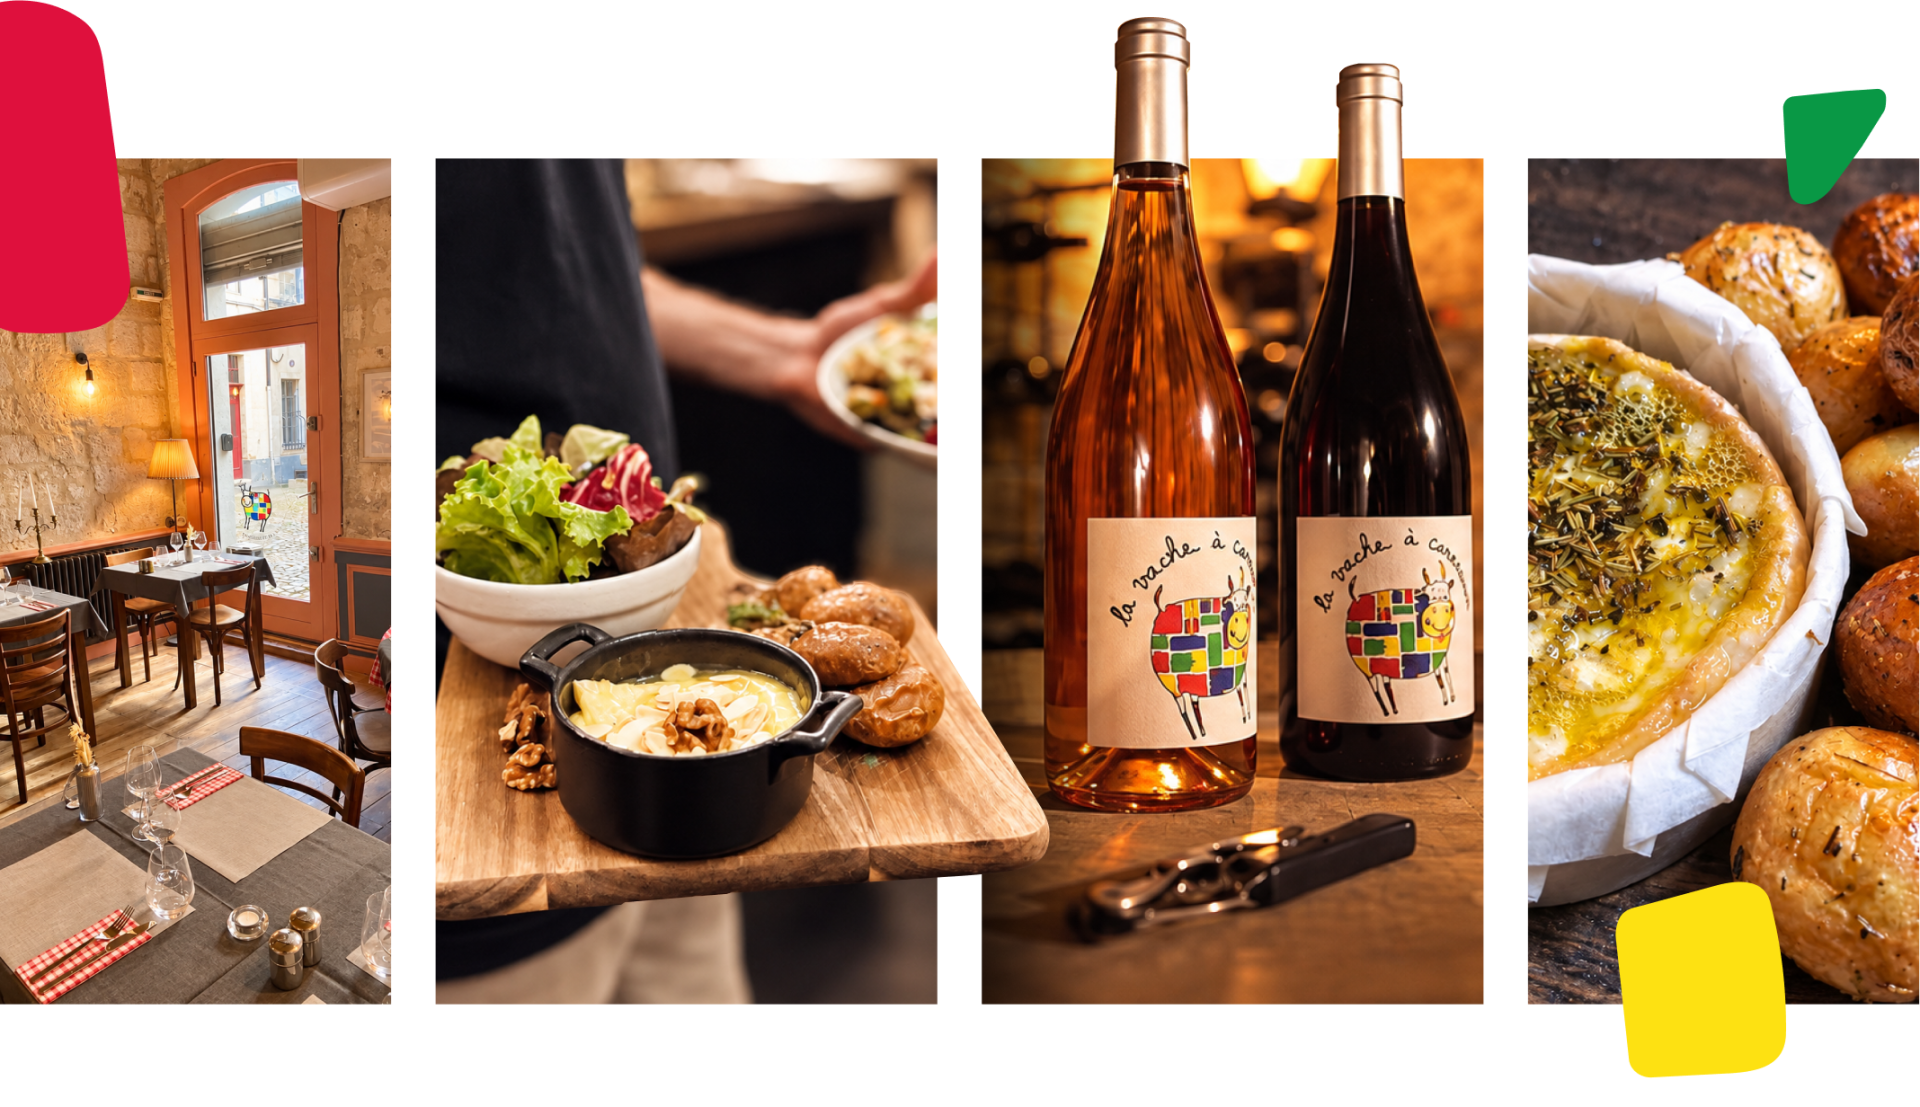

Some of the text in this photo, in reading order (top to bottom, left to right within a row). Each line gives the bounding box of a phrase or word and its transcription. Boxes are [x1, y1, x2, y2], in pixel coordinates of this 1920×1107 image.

[1110, 600, 1136, 627] la
[1132, 535, 1201, 590] vache
[1211, 530, 1226, 550] à
[1313, 527, 1419, 614] la vache à
